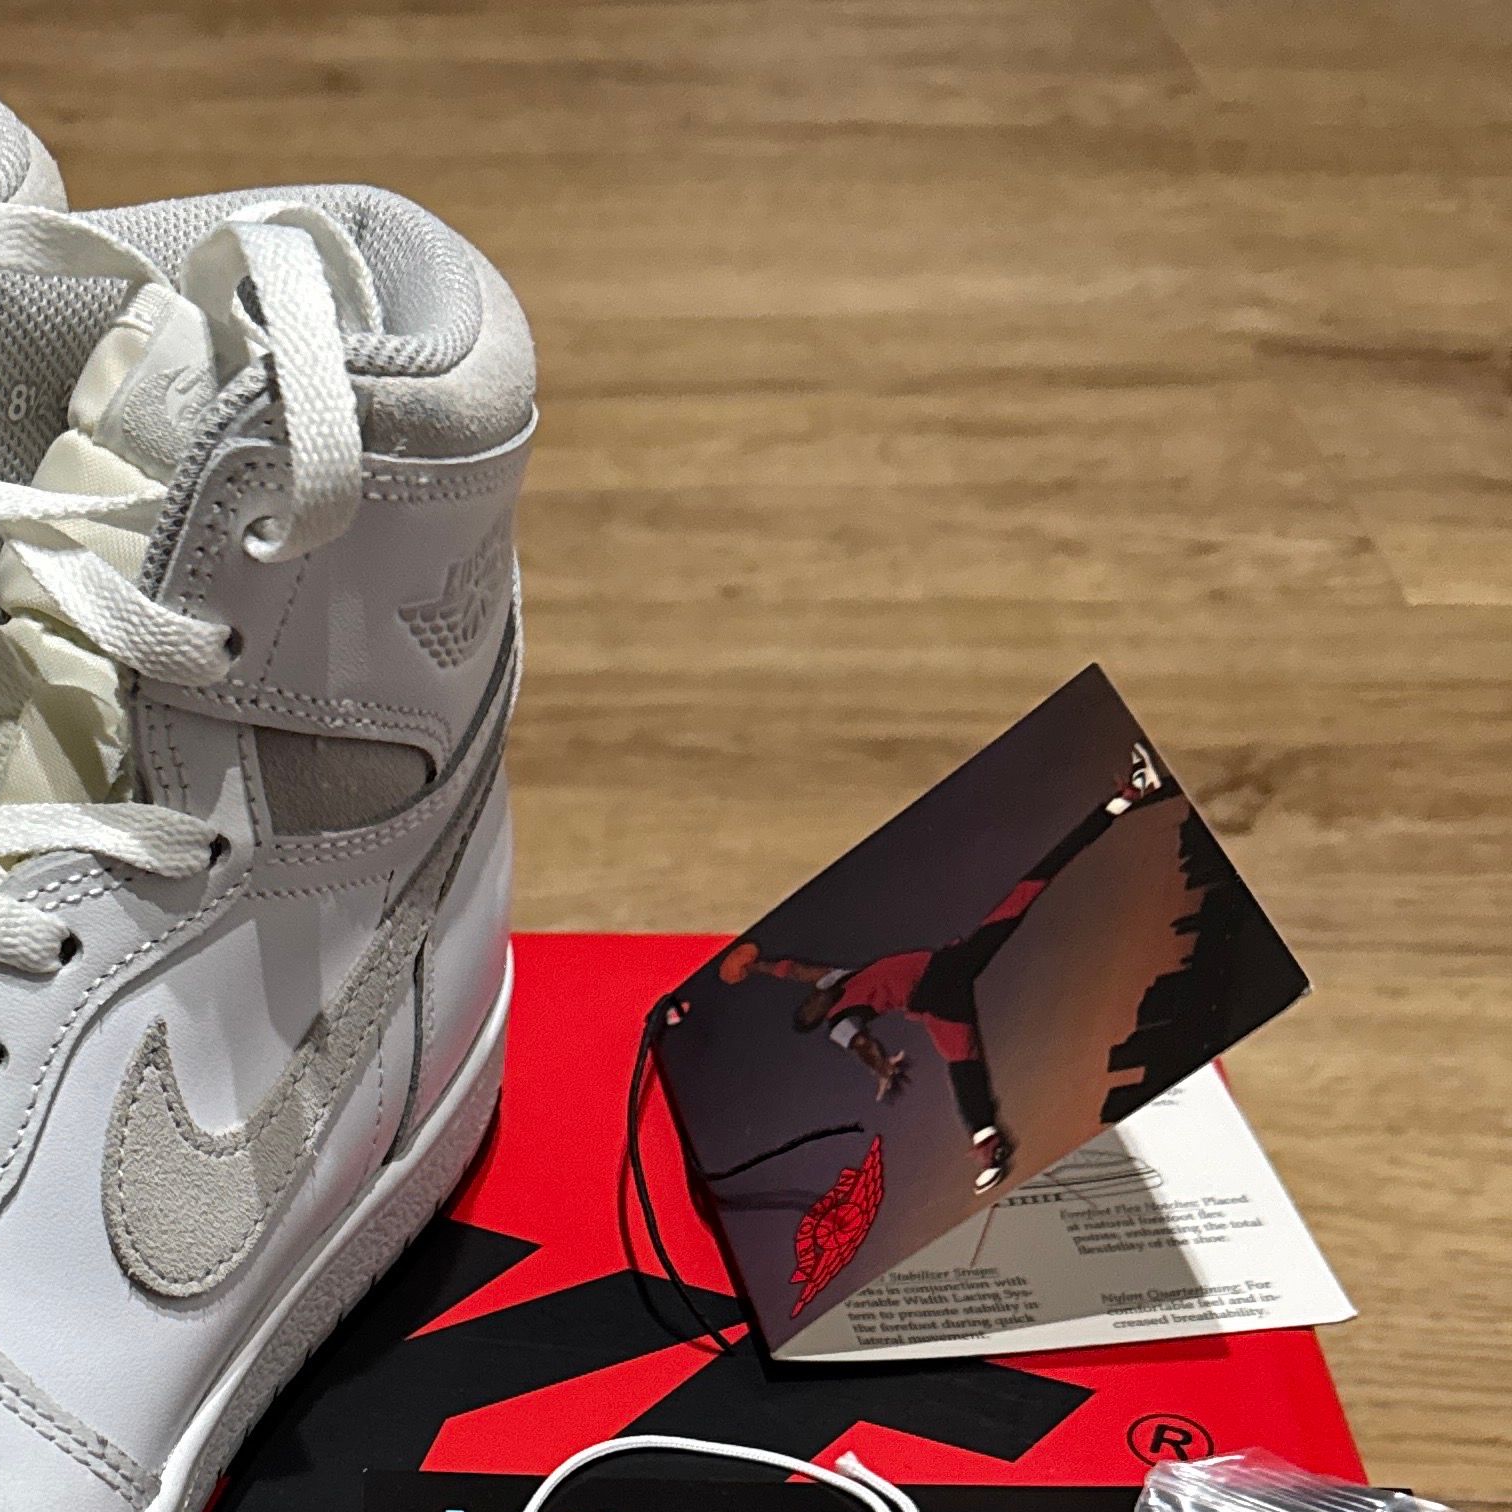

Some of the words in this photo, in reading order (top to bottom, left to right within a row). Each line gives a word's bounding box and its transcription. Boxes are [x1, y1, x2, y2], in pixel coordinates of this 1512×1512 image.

[1201, 1194, 1249, 1207] Placed
[1083, 1219, 1135, 1230] natural
[1203, 1222, 1227, 1231] the
[1229, 1217, 1262, 1229] total
[1165, 1236, 1189, 1248] the
[994, 1275, 1028, 1288] with
[1245, 1280, 1272, 1291] For
[903, 1294, 948, 1305] Width
[1228, 1294, 1256, 1305] and
[962, 1300, 1020, 1315] stability
[852, 1323, 877, 1333] the
[940, 1319, 993, 1330] during
[994, 1313, 1036, 1328] quick
[1112, 1315, 1169, 1329] creased
